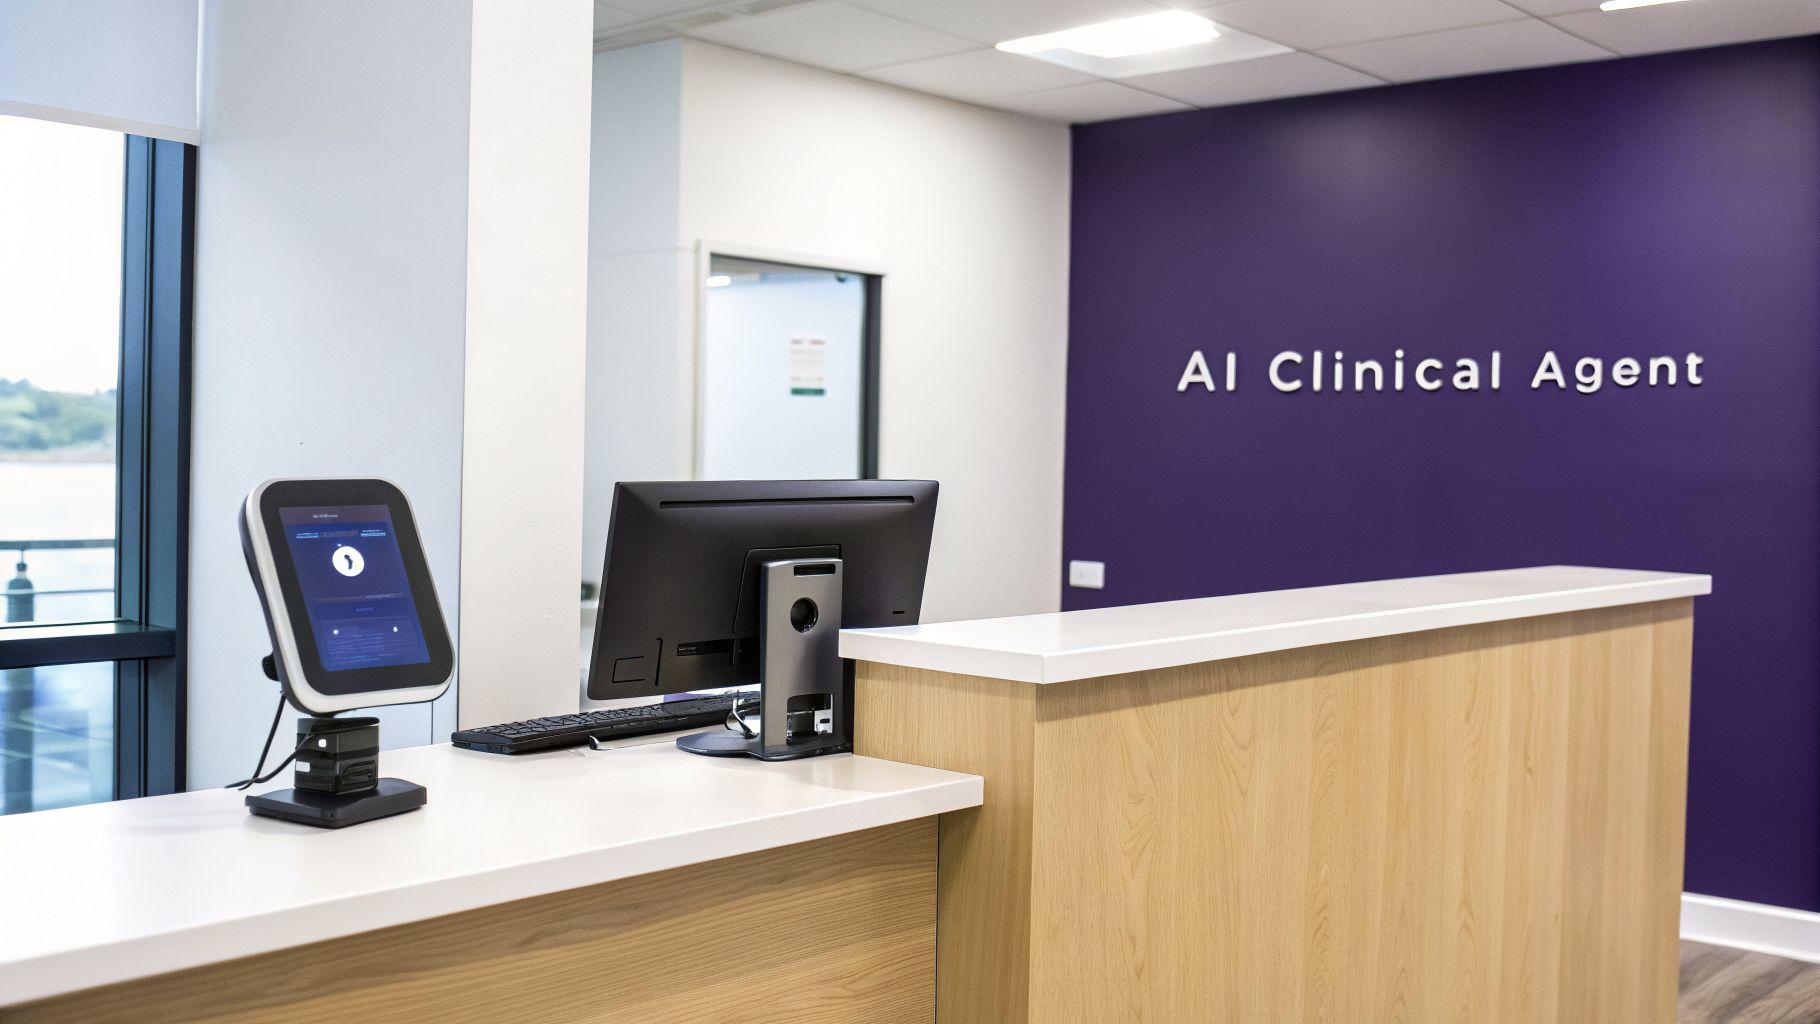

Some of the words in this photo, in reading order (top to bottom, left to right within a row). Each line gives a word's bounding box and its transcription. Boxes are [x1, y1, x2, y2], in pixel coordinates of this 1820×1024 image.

[1177, 350, 1236, 391] AI
[1268, 349, 1501, 392] Clinical
[1531, 351, 1704, 394] Agent
